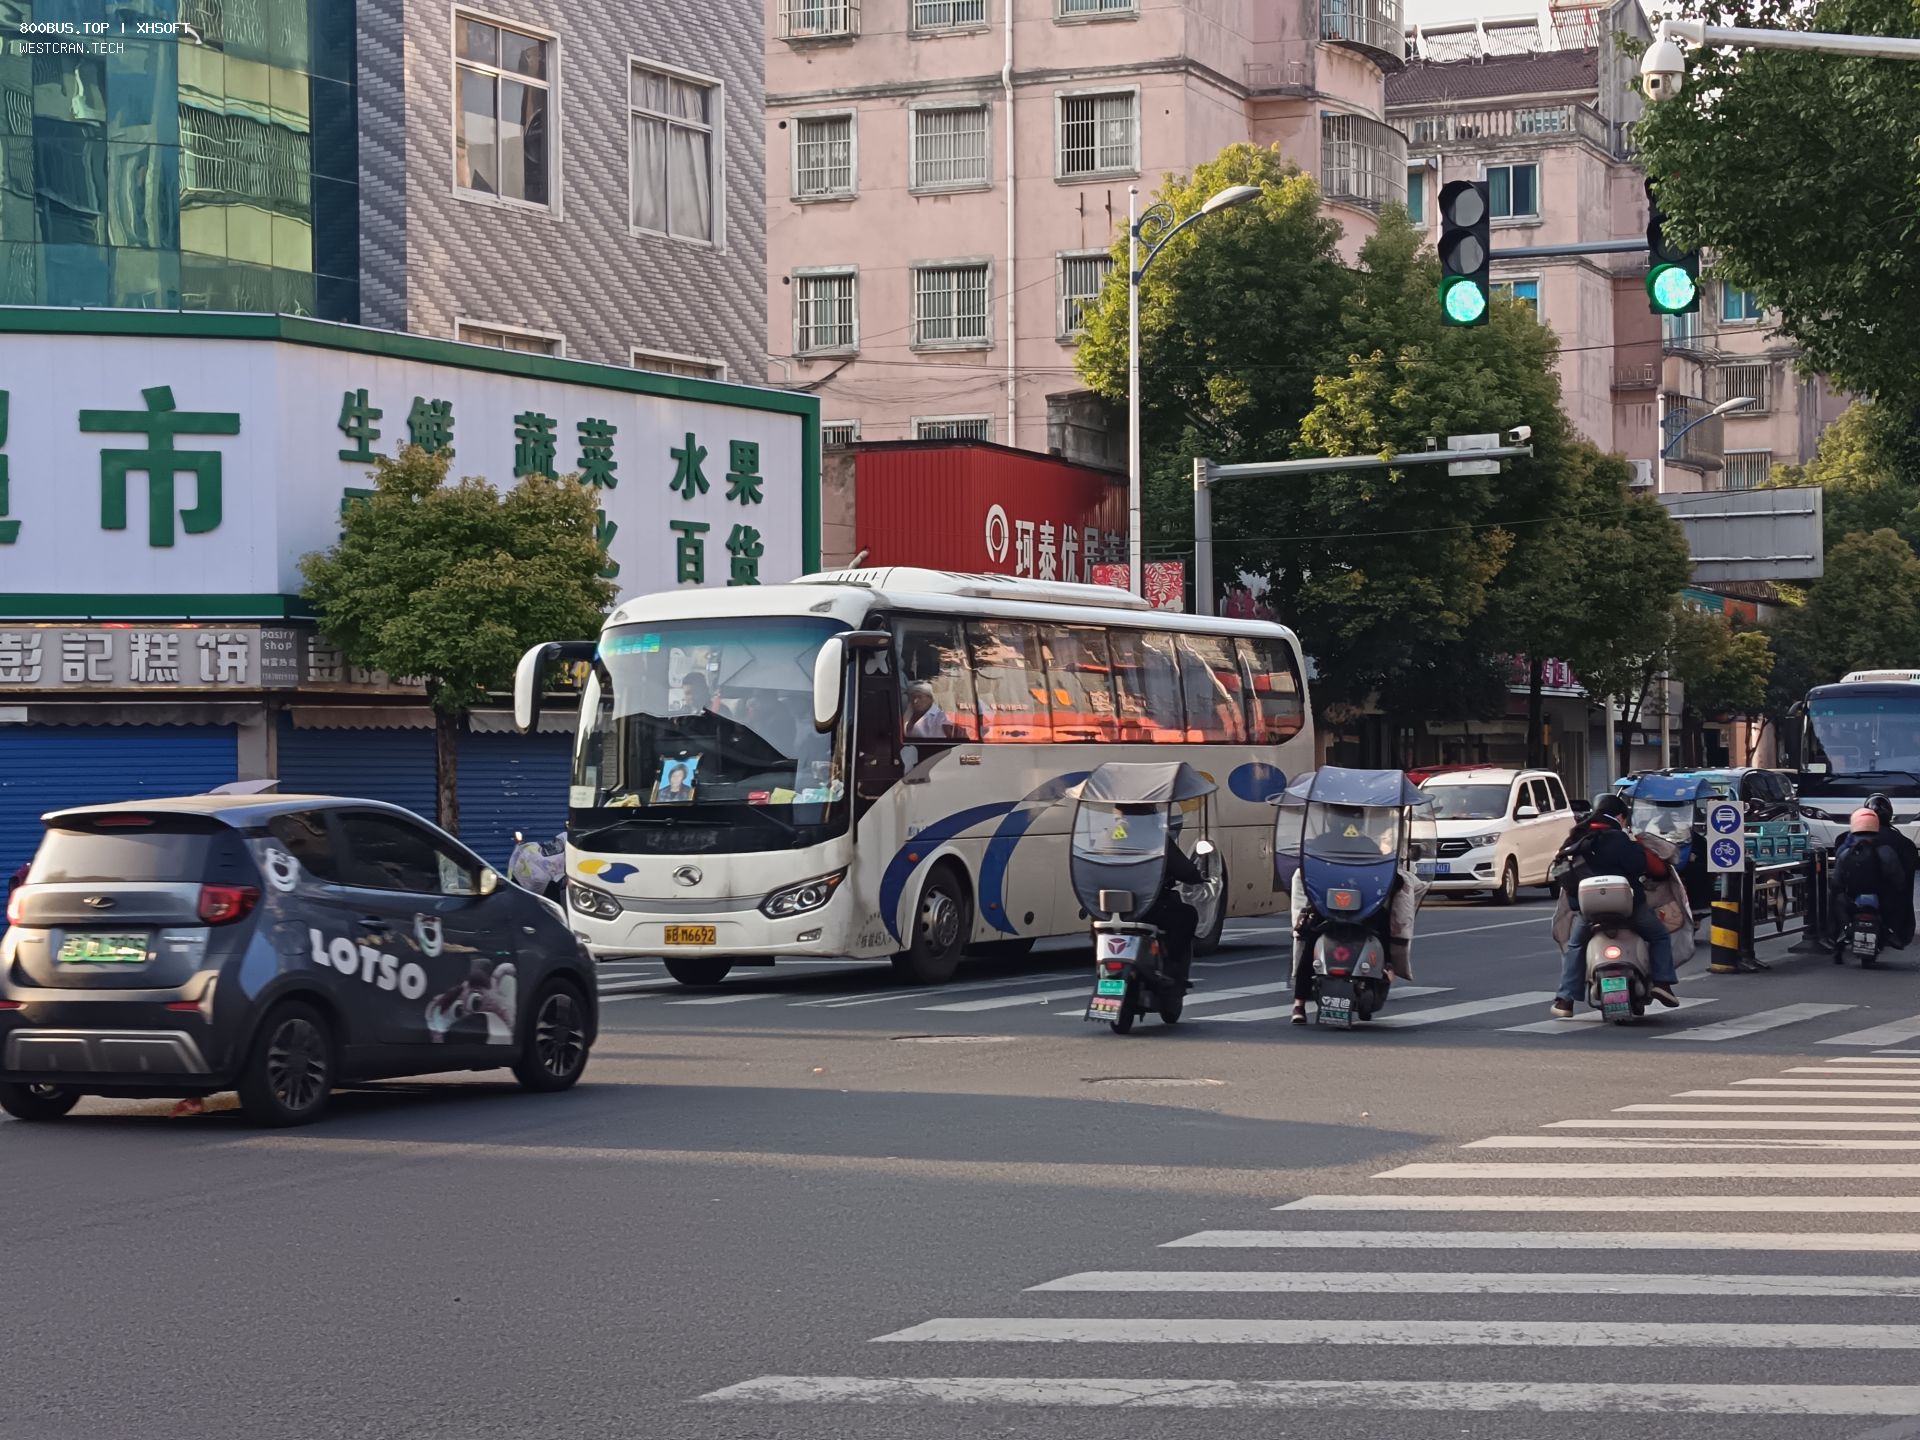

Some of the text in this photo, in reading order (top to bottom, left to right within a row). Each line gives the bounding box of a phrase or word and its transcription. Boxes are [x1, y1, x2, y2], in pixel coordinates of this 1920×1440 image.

[0, 385, 240, 547] 市
[338, 388, 764, 506] 生鲜 蔬菜 水果
[669, 519, 765, 586] 百货
[1014, 519, 1131, 584] 珂泰优居
[264, 640, 292, 650] shop
[309, 928, 428, 1000] LOTSO
